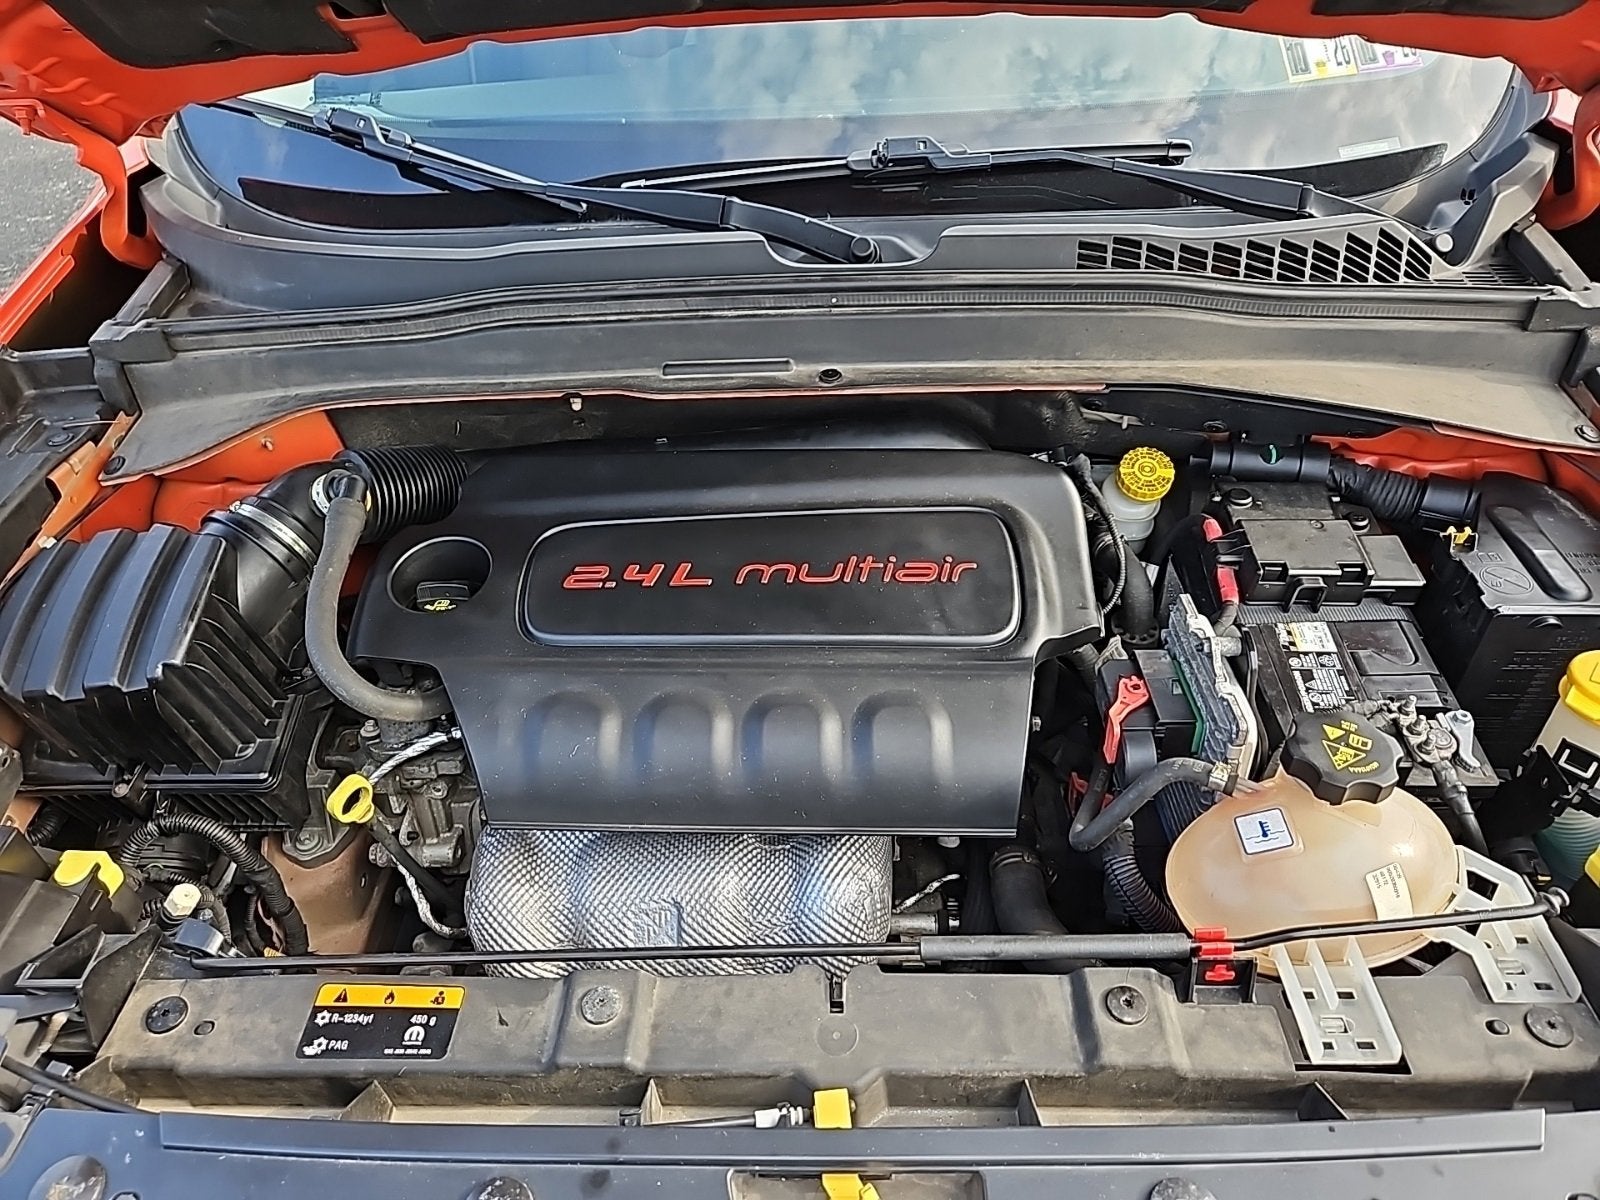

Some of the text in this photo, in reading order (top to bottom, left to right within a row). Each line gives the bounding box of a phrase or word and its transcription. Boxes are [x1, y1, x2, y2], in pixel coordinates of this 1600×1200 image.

[563, 555, 978, 589] 2.4L multiair
[409, 1014, 428, 1024] 450
[328, 1040, 349, 1050] PAG
